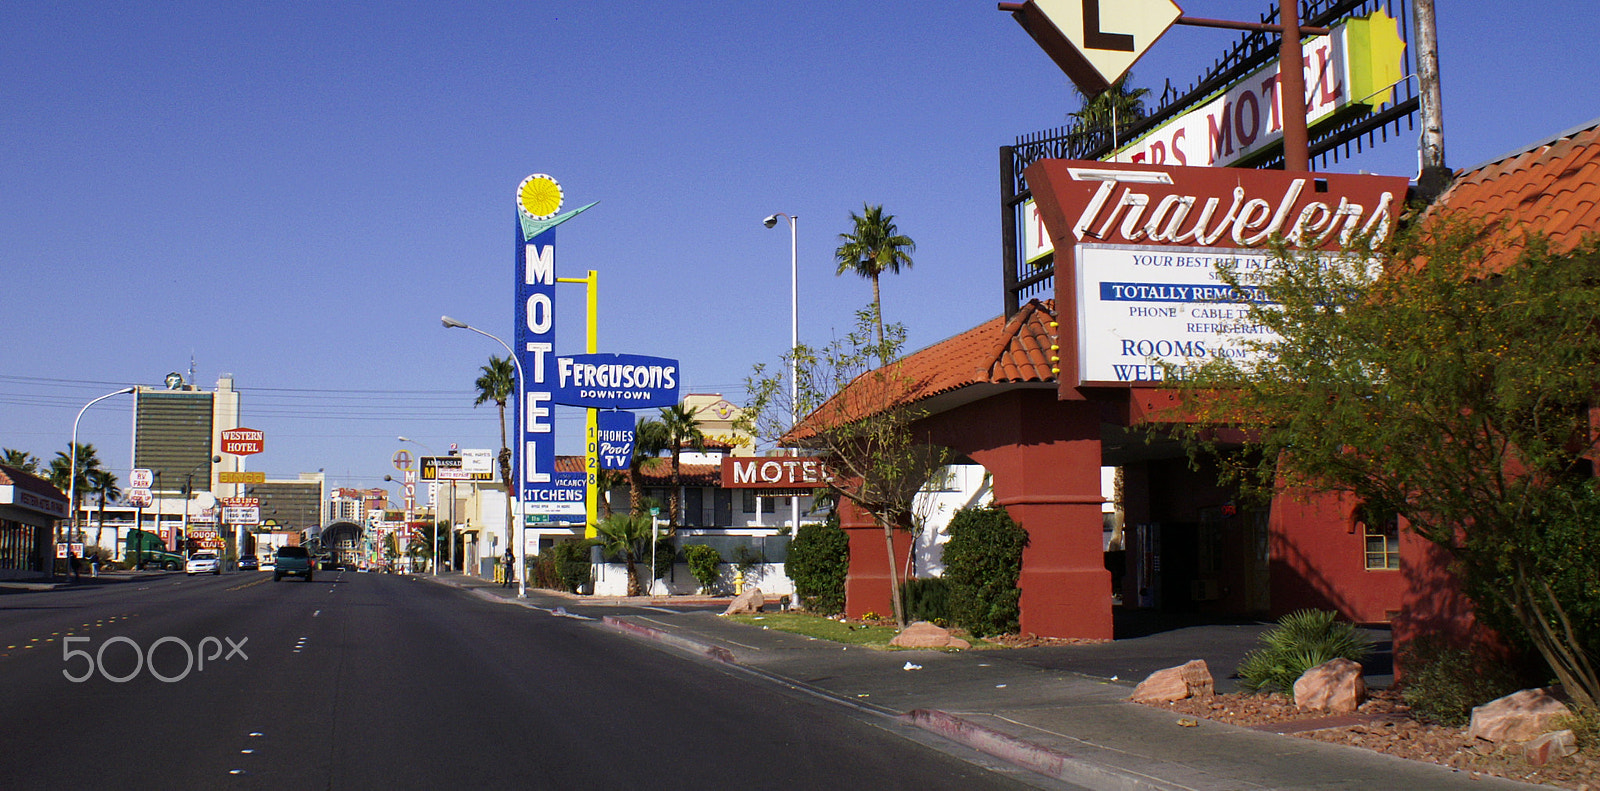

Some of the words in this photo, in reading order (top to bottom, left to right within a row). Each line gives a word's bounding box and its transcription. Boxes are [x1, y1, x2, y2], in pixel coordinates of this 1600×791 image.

[1067, 168, 1393, 250] Travelers
[1133, 254, 1172, 267] YOUR
[1176, 256, 1212, 268] BEST
[1112, 285, 1189, 300] TOTALLY
[1129, 306, 1177, 317] PHONE
[1191, 308, 1233, 319] CABLE
[1121, 339, 1206, 357] ROOMS
[1211, 348, 1247, 358] FROM
[525, 244, 554, 483] MOTEL
[581, 389, 651, 400] DOWNTOWN
[222, 431, 263, 441] WESTERN
[597, 429, 634, 442] PHONES
[227, 442, 259, 452] HOTEL
[600, 442, 630, 456] Pool
[588, 426, 596, 485] 1028
[604, 456, 626, 467] TV
[220, 472, 263, 483] BINGO
[733, 460, 835, 484] MOTEL
[554, 479, 587, 487] VACANCY
[524, 489, 583, 501] KITCHENS
[404, 471, 415, 535] MOTEL
